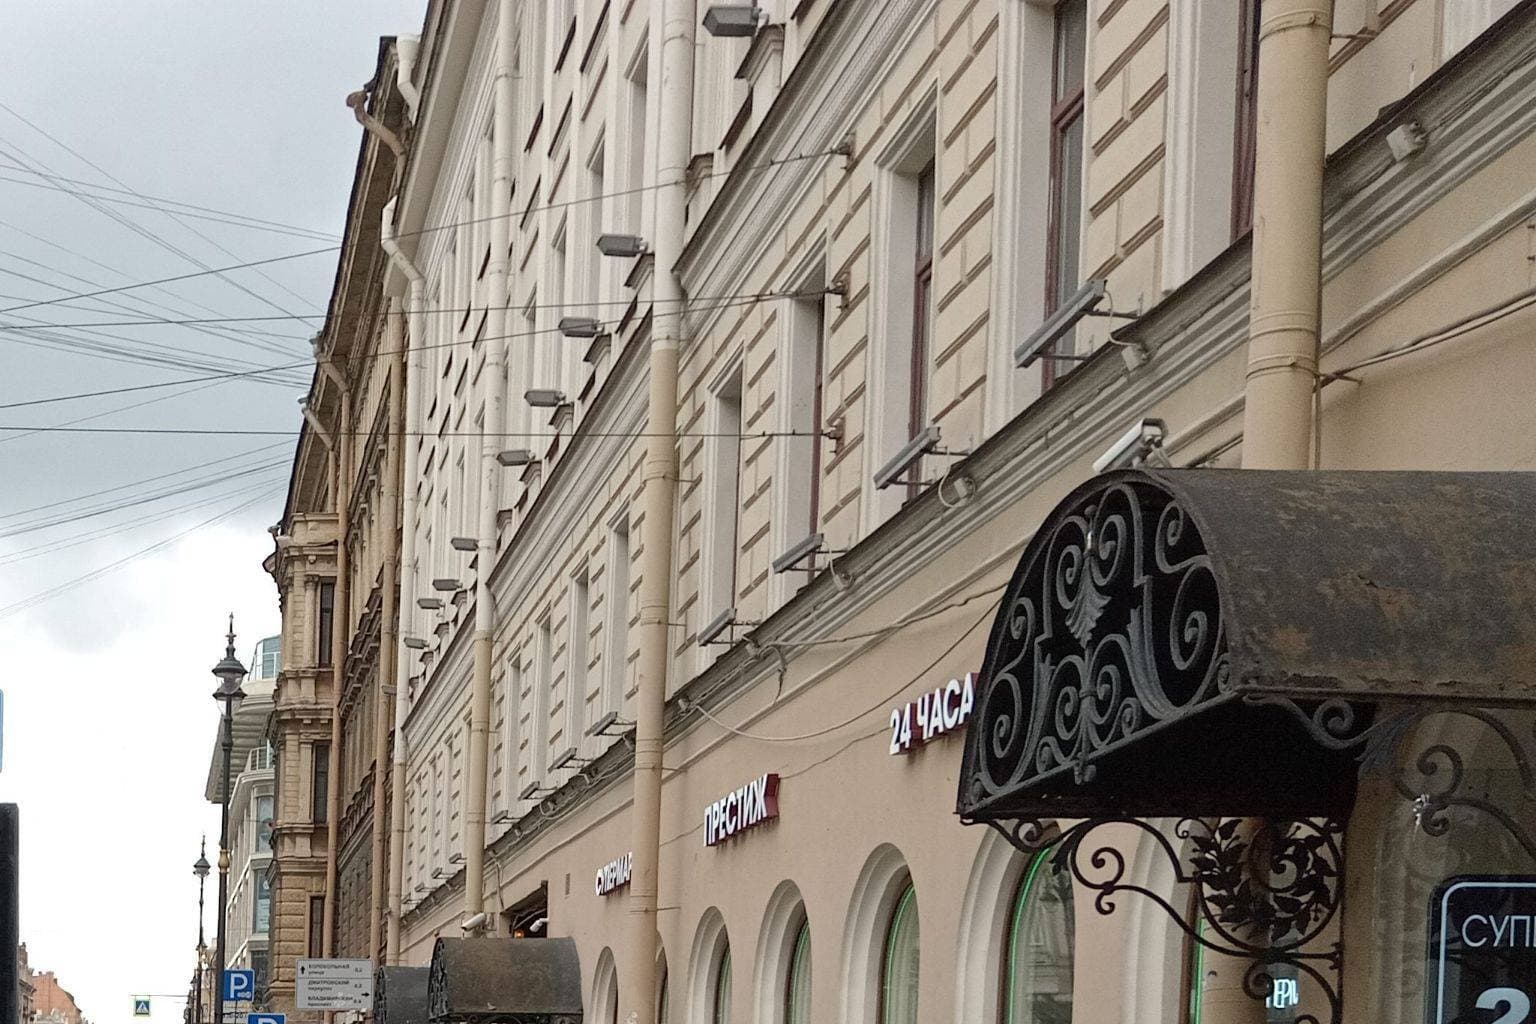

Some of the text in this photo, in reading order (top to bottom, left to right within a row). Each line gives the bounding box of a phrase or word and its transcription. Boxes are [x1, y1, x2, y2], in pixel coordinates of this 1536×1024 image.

[889, 672, 973, 755] 24 ЧАСА
[704, 773, 767, 847] ПРЕСТИЖ
[1462, 914, 1536, 948] СУП
[230, 973, 248, 998] P
